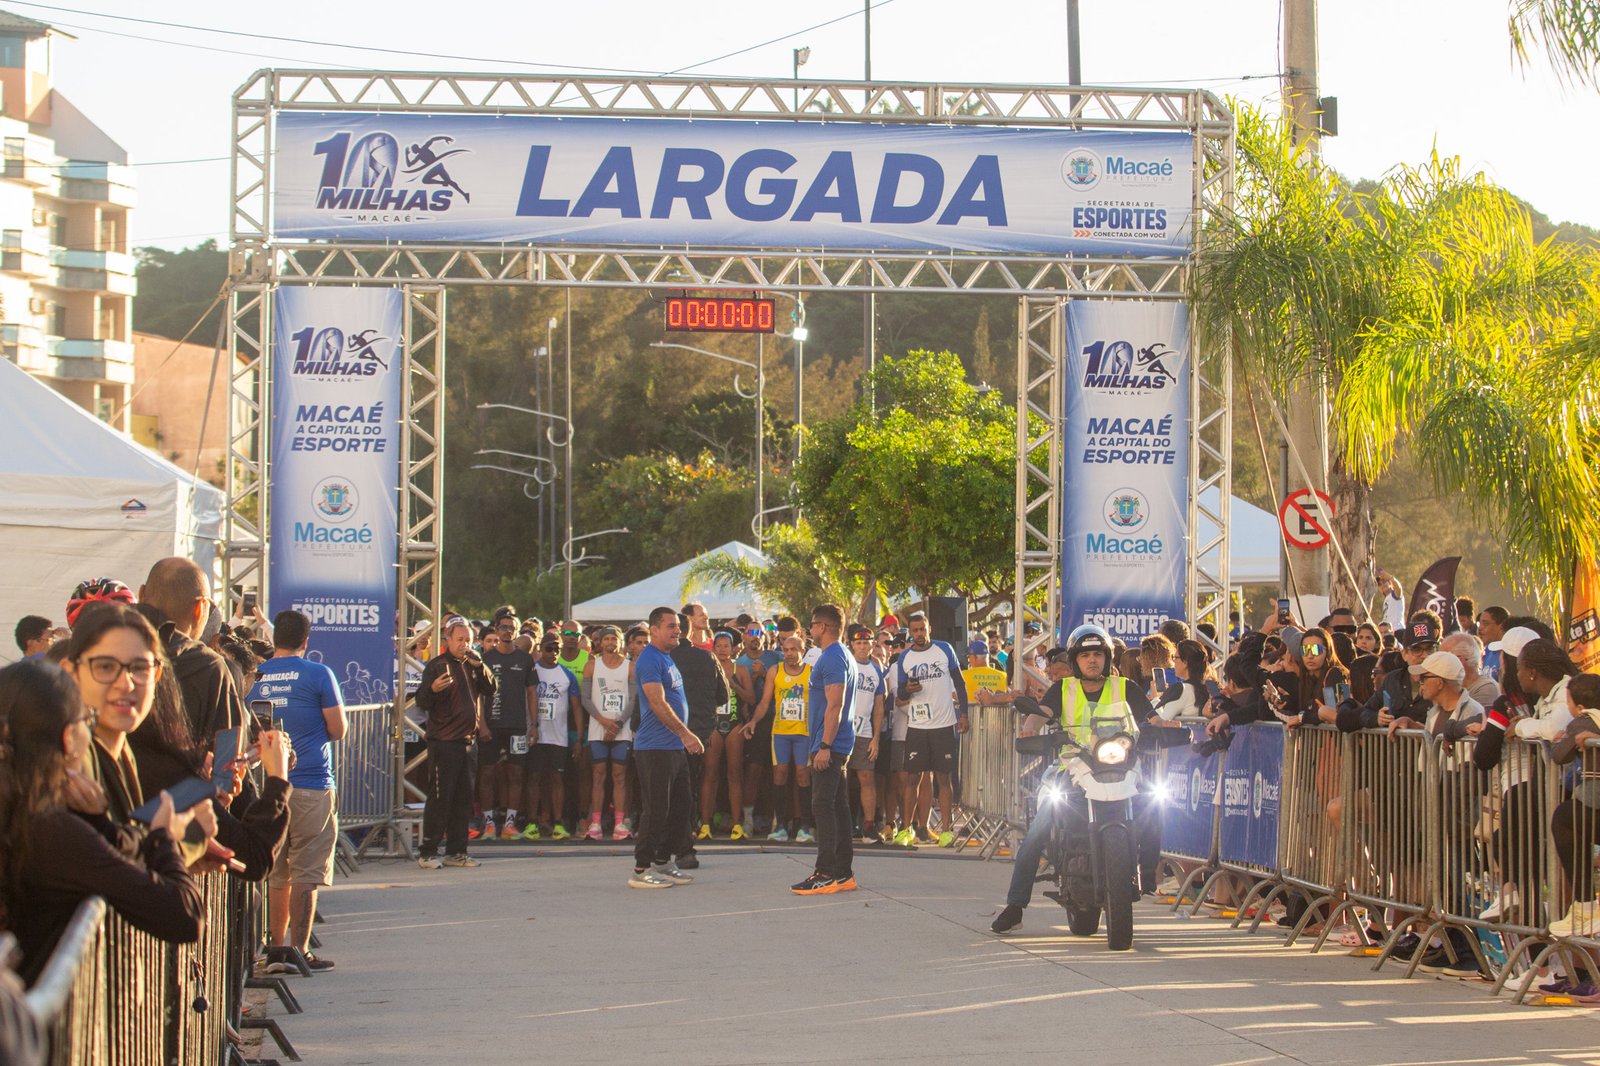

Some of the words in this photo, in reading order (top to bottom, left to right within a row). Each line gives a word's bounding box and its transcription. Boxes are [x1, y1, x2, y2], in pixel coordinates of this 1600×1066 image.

[313, 131, 399, 196] 10
[1106, 157, 1173, 176] Macaé
[516, 145, 1008, 227] LARGADA
[317, 187, 453, 211] MILHAS
[358, 213, 411, 222] MACAÉ
[1073, 207, 1167, 230] ESPORTES
[1150, 231, 1166, 239] VOCÊ
[292, 327, 344, 364] 10
[293, 361, 378, 376] MILHAS
[1082, 341, 1134, 378] 10
[1084, 375, 1166, 389] MILHAS
[295, 401, 384, 423] MACAÉ
[296, 425, 305, 434] A
[308, 425, 360, 435] CAPITAL
[363, 426, 382, 435] DO
[1087, 414, 1173, 436] MACAÉ
[291, 437, 387, 453] ESPORTE
[1087, 437, 1096, 446] A
[1099, 437, 1150, 447] CAPITAL
[1152, 438, 1171, 447] DO
[1082, 449, 1176, 465] ESPORTE
[294, 522, 372, 543] Macaé
[1086, 533, 1163, 554] Macaé
